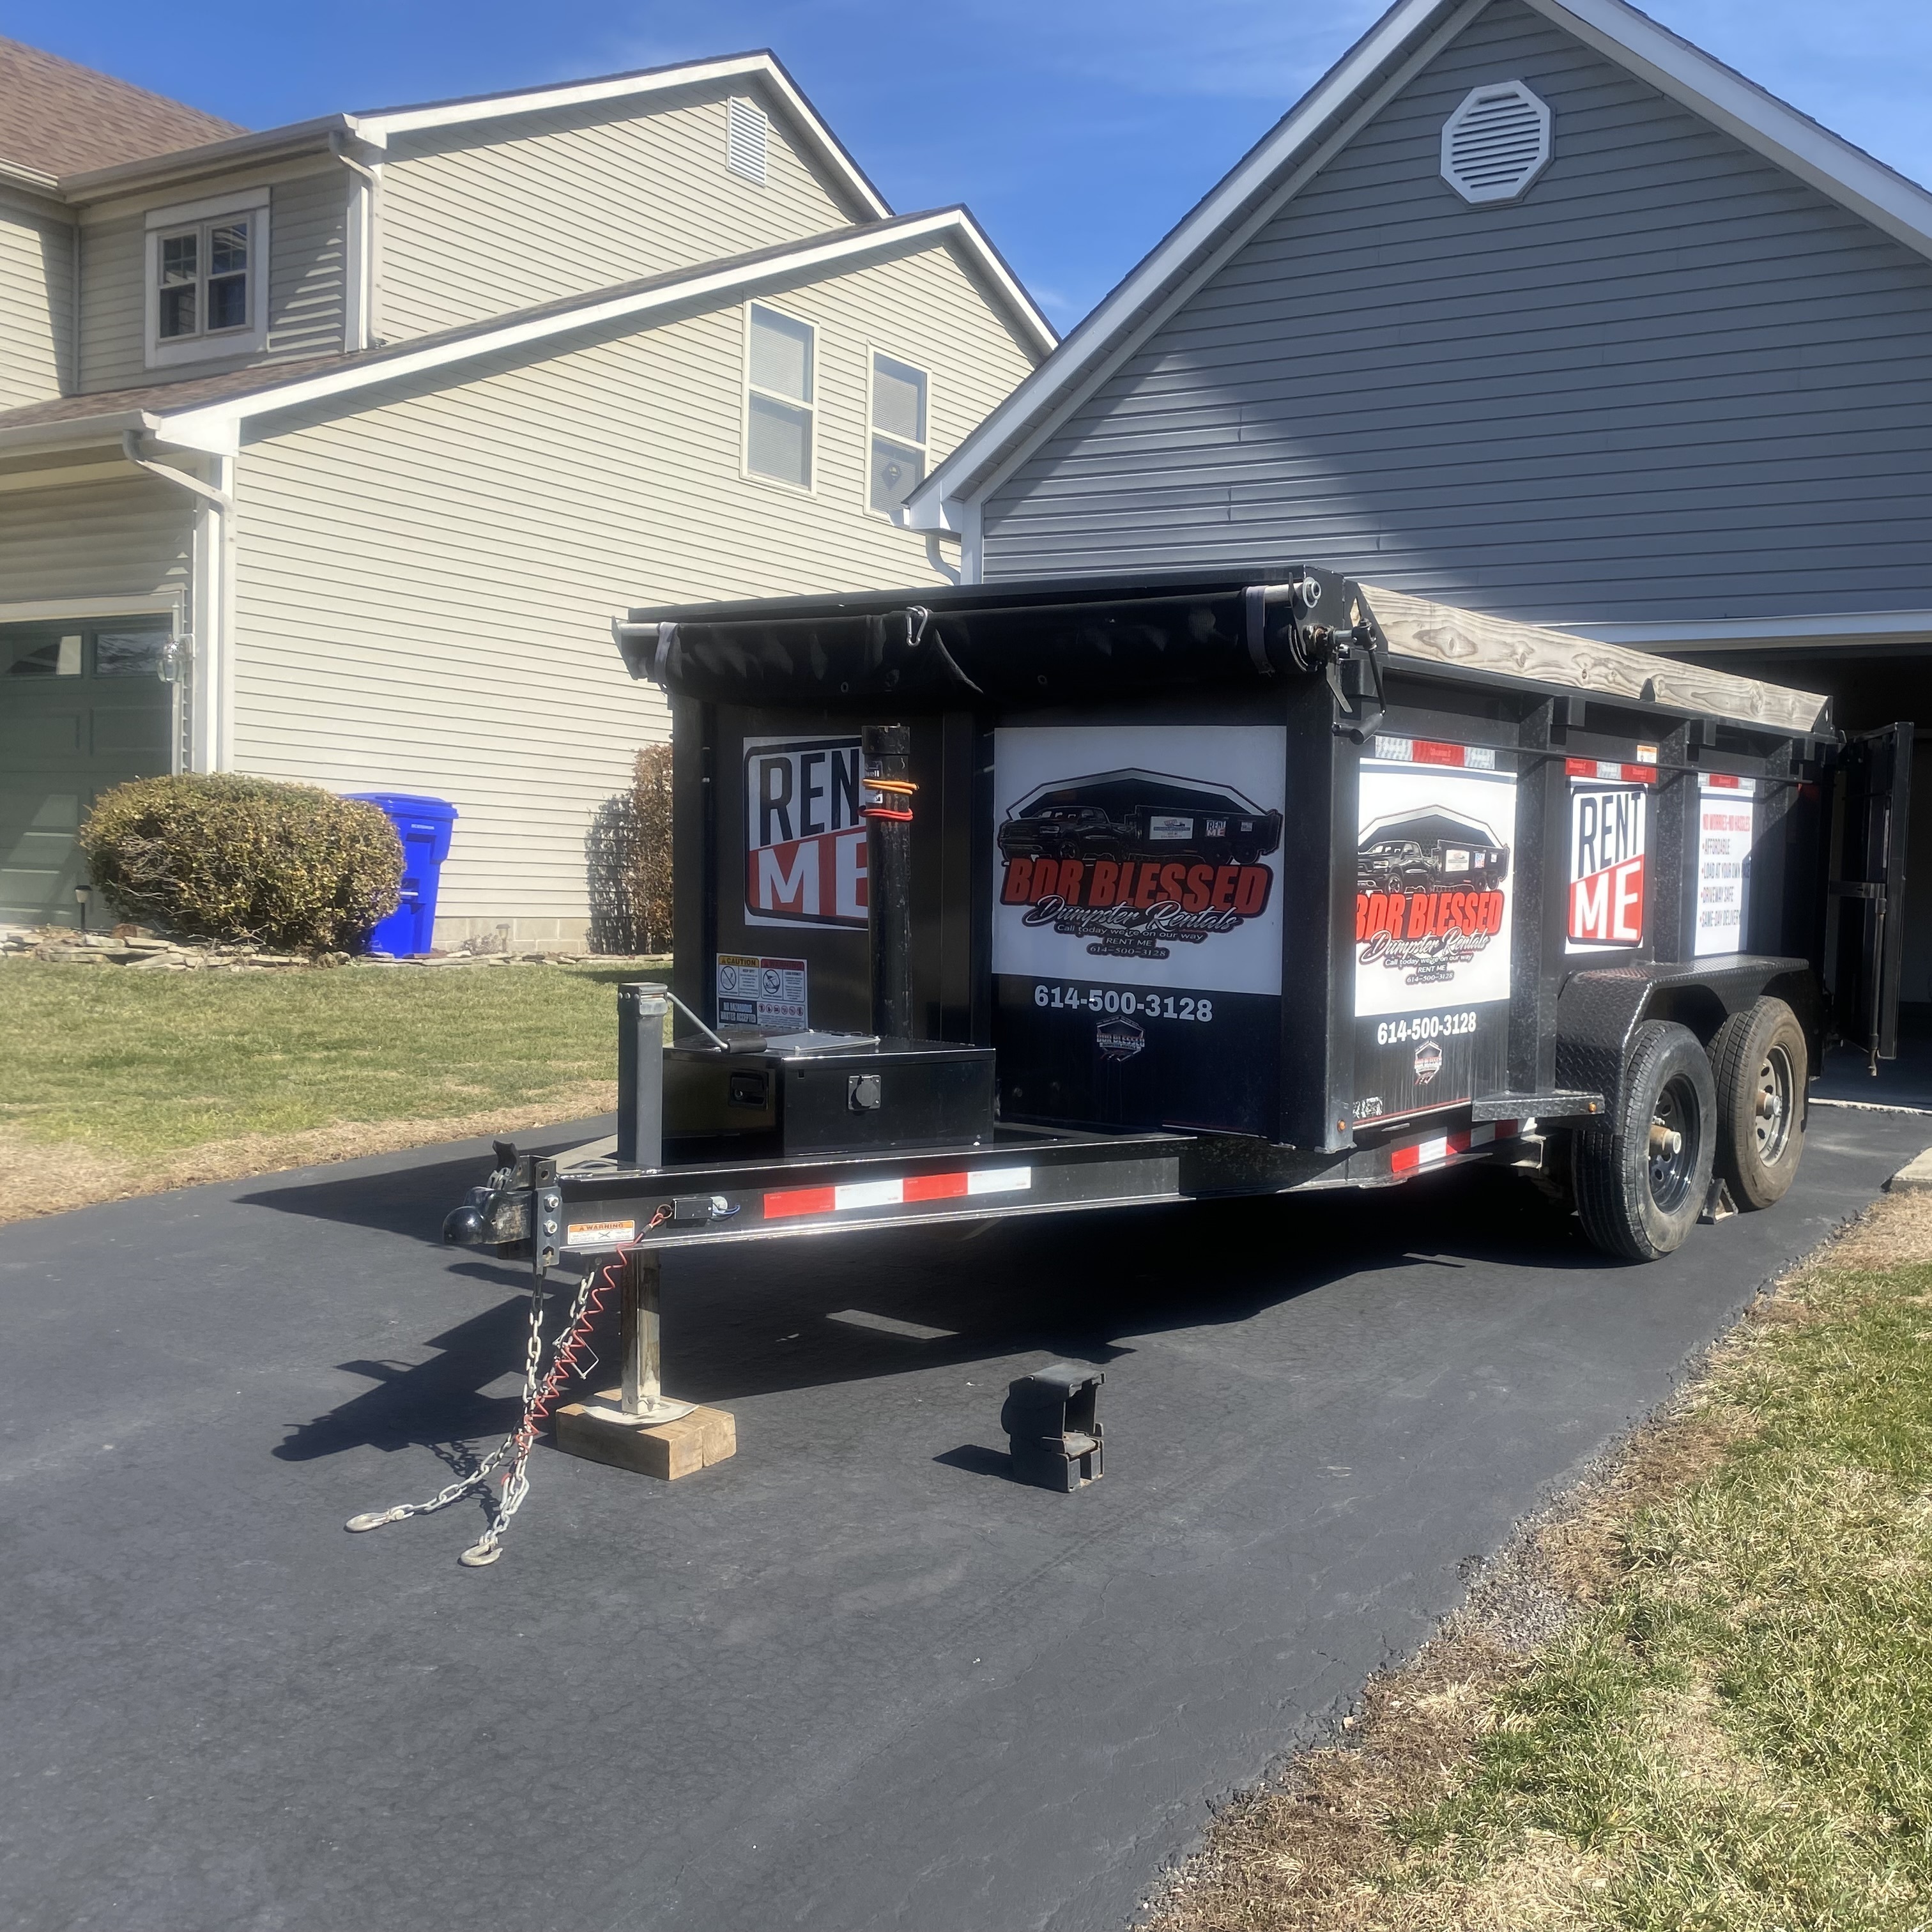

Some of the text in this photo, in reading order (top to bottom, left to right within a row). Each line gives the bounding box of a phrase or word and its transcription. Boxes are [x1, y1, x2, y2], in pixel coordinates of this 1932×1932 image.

[760, 748, 859, 847] REN
[1206, 820, 1226, 831] RENT
[1577, 792, 1641, 879] RENT
[1735, 815, 1751, 832] HASSLES
[1704, 838, 1731, 855] AFFORDABLE
[758, 832, 868, 919] ME
[1088, 861, 1268, 914] BLESSED
[1703, 862, 1715, 879] LOAD
[1715, 862, 1721, 878] AT
[1721, 862, 1731, 878] YOUR
[1732, 862, 1740, 878] OWN
[1574, 861, 1641, 940] ME
[1703, 886, 1735, 903] DRIVEWAY SAFE
[1025, 894, 1239, 932] Dumpster Rentals
[1407, 892, 1502, 939] BLESSED
[1701, 909, 1741, 928] SAME-DAY DELIVERY
[1078, 926, 1108, 935] today
[1360, 926, 1491, 962] Dumpster Rentals
[1089, 946, 1166, 956] 614-500-3128
[1407, 972, 1453, 983] 614-500-3128
[1034, 985, 1213, 1022] 614-500-3128
[1377, 1011, 1476, 1045] 614-500-3128
